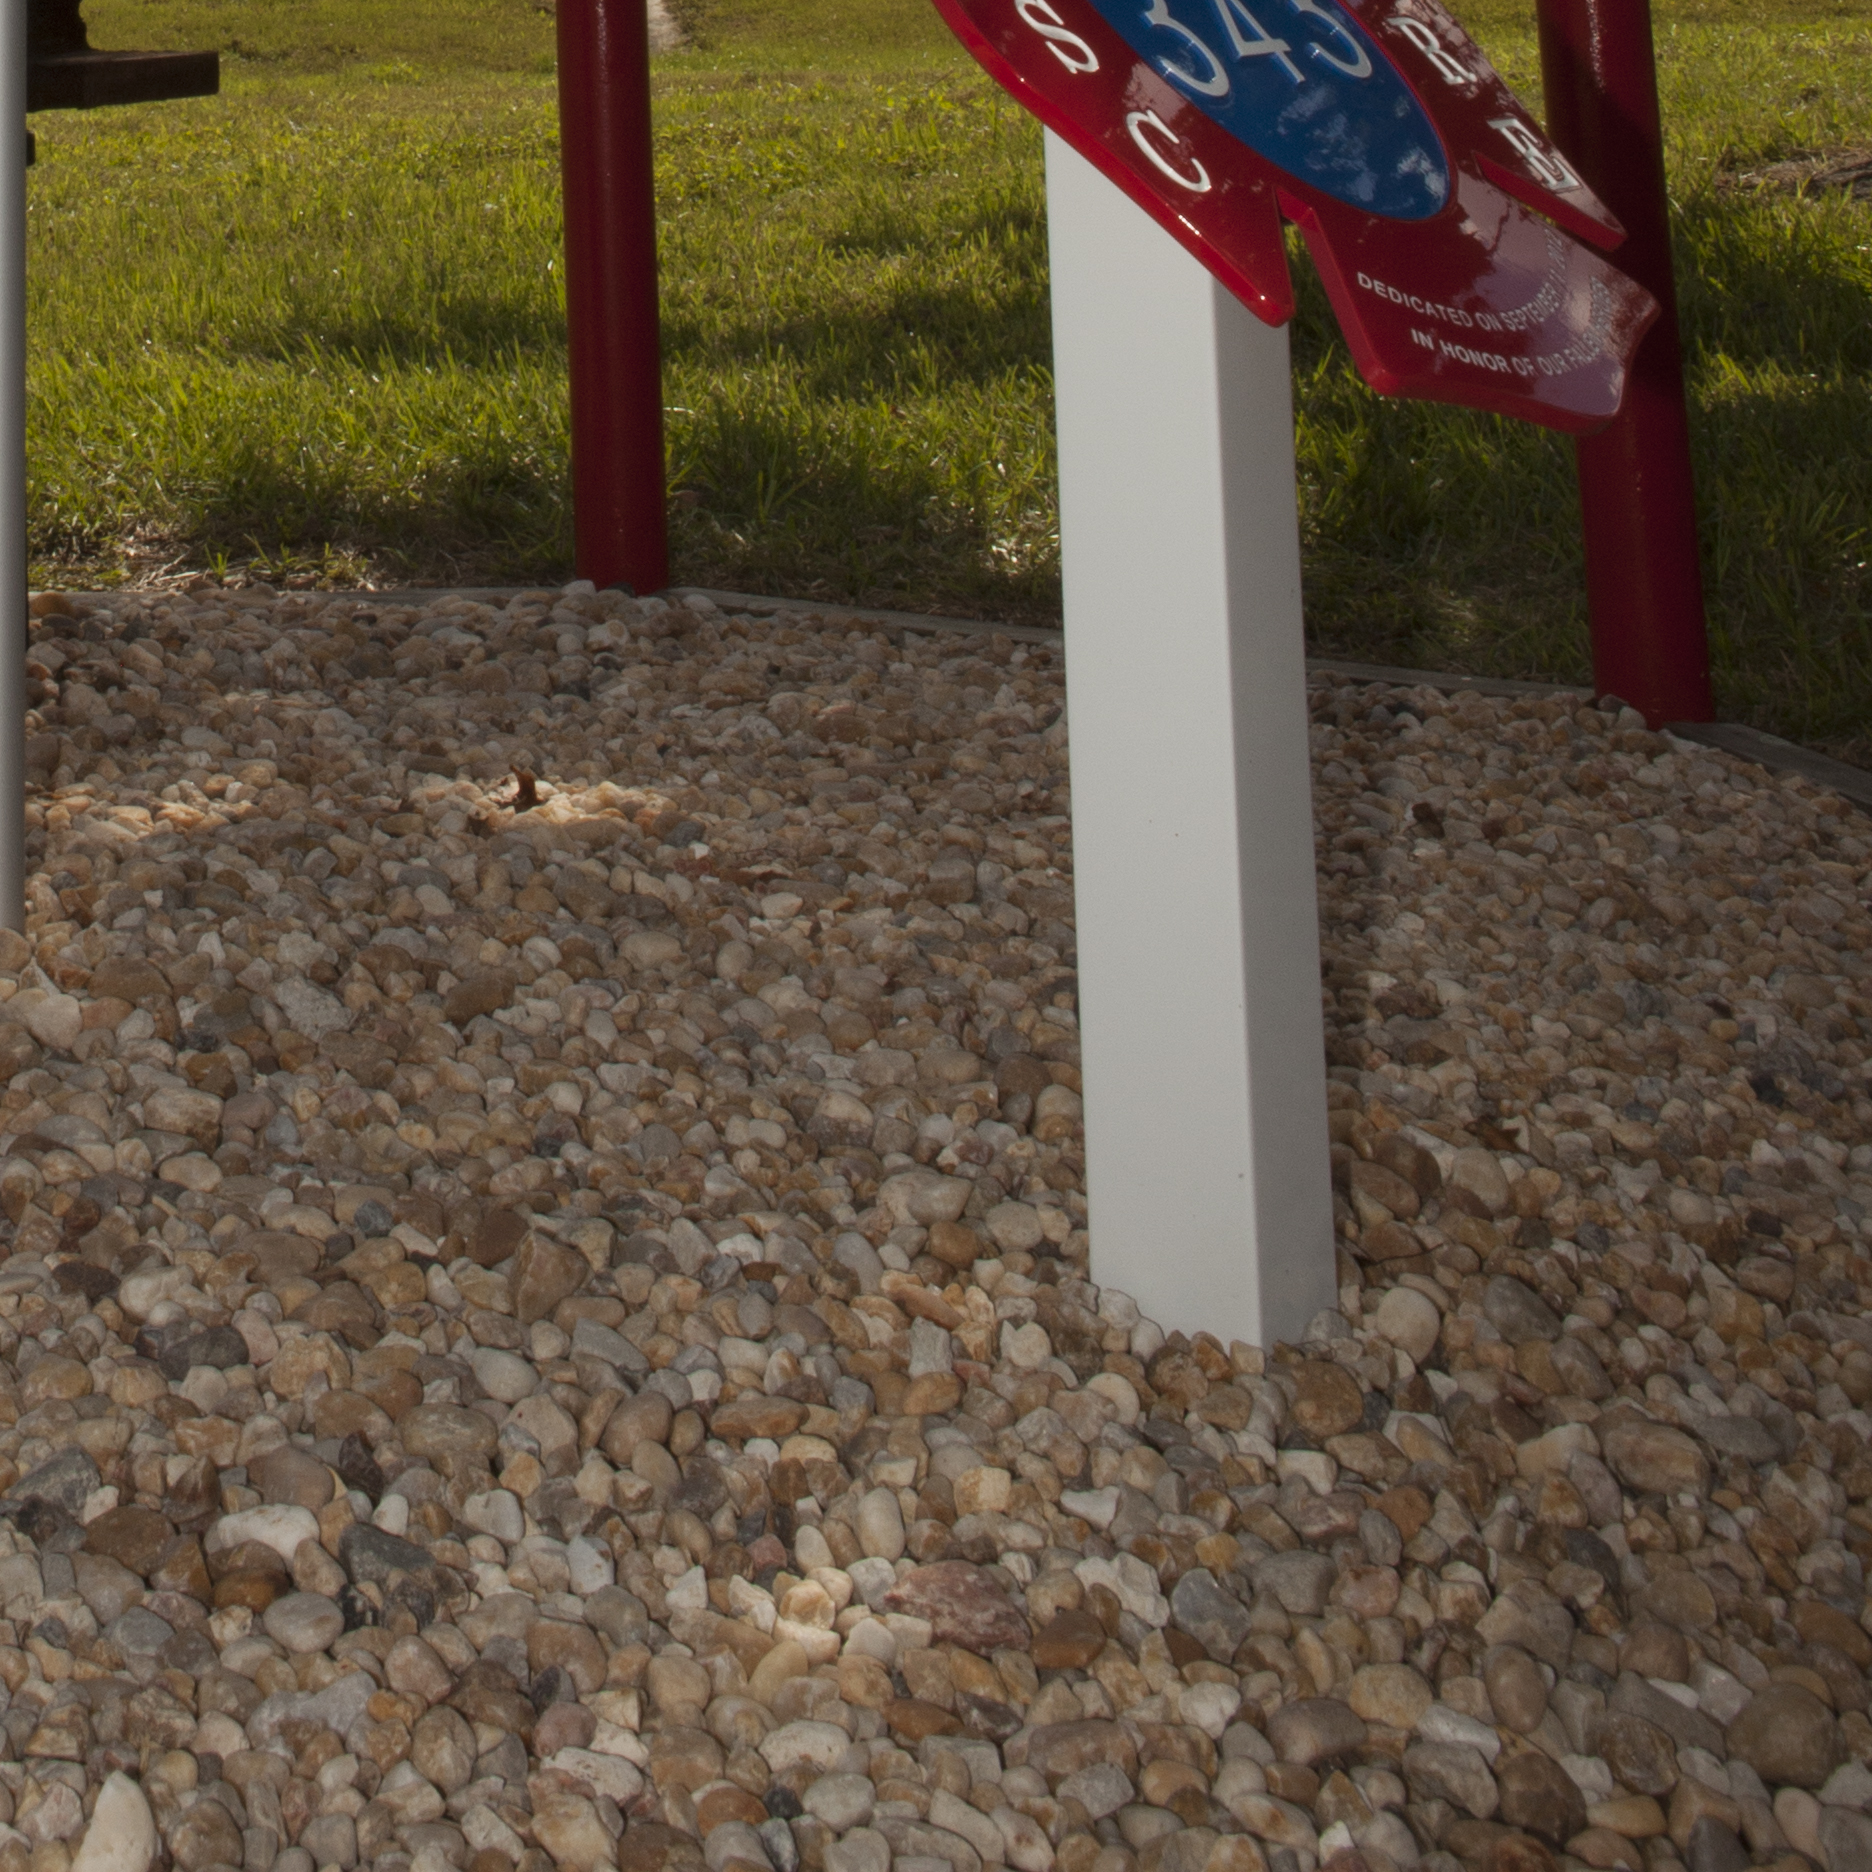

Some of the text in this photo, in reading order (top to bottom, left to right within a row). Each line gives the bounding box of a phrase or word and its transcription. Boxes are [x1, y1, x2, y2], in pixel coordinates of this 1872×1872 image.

[1357, 271, 1473, 328] DEDICATED
[1475, 312, 1502, 332] ON
[1500, 282, 1565, 332] SEPTEMBER
[1411, 328, 1435, 350] IN
[1439, 339, 1512, 374] HONOR
[1511, 357, 1539, 377] OF
[1537, 353, 1571, 376] OUR
[1563, 332, 1605, 368] FALLEN
